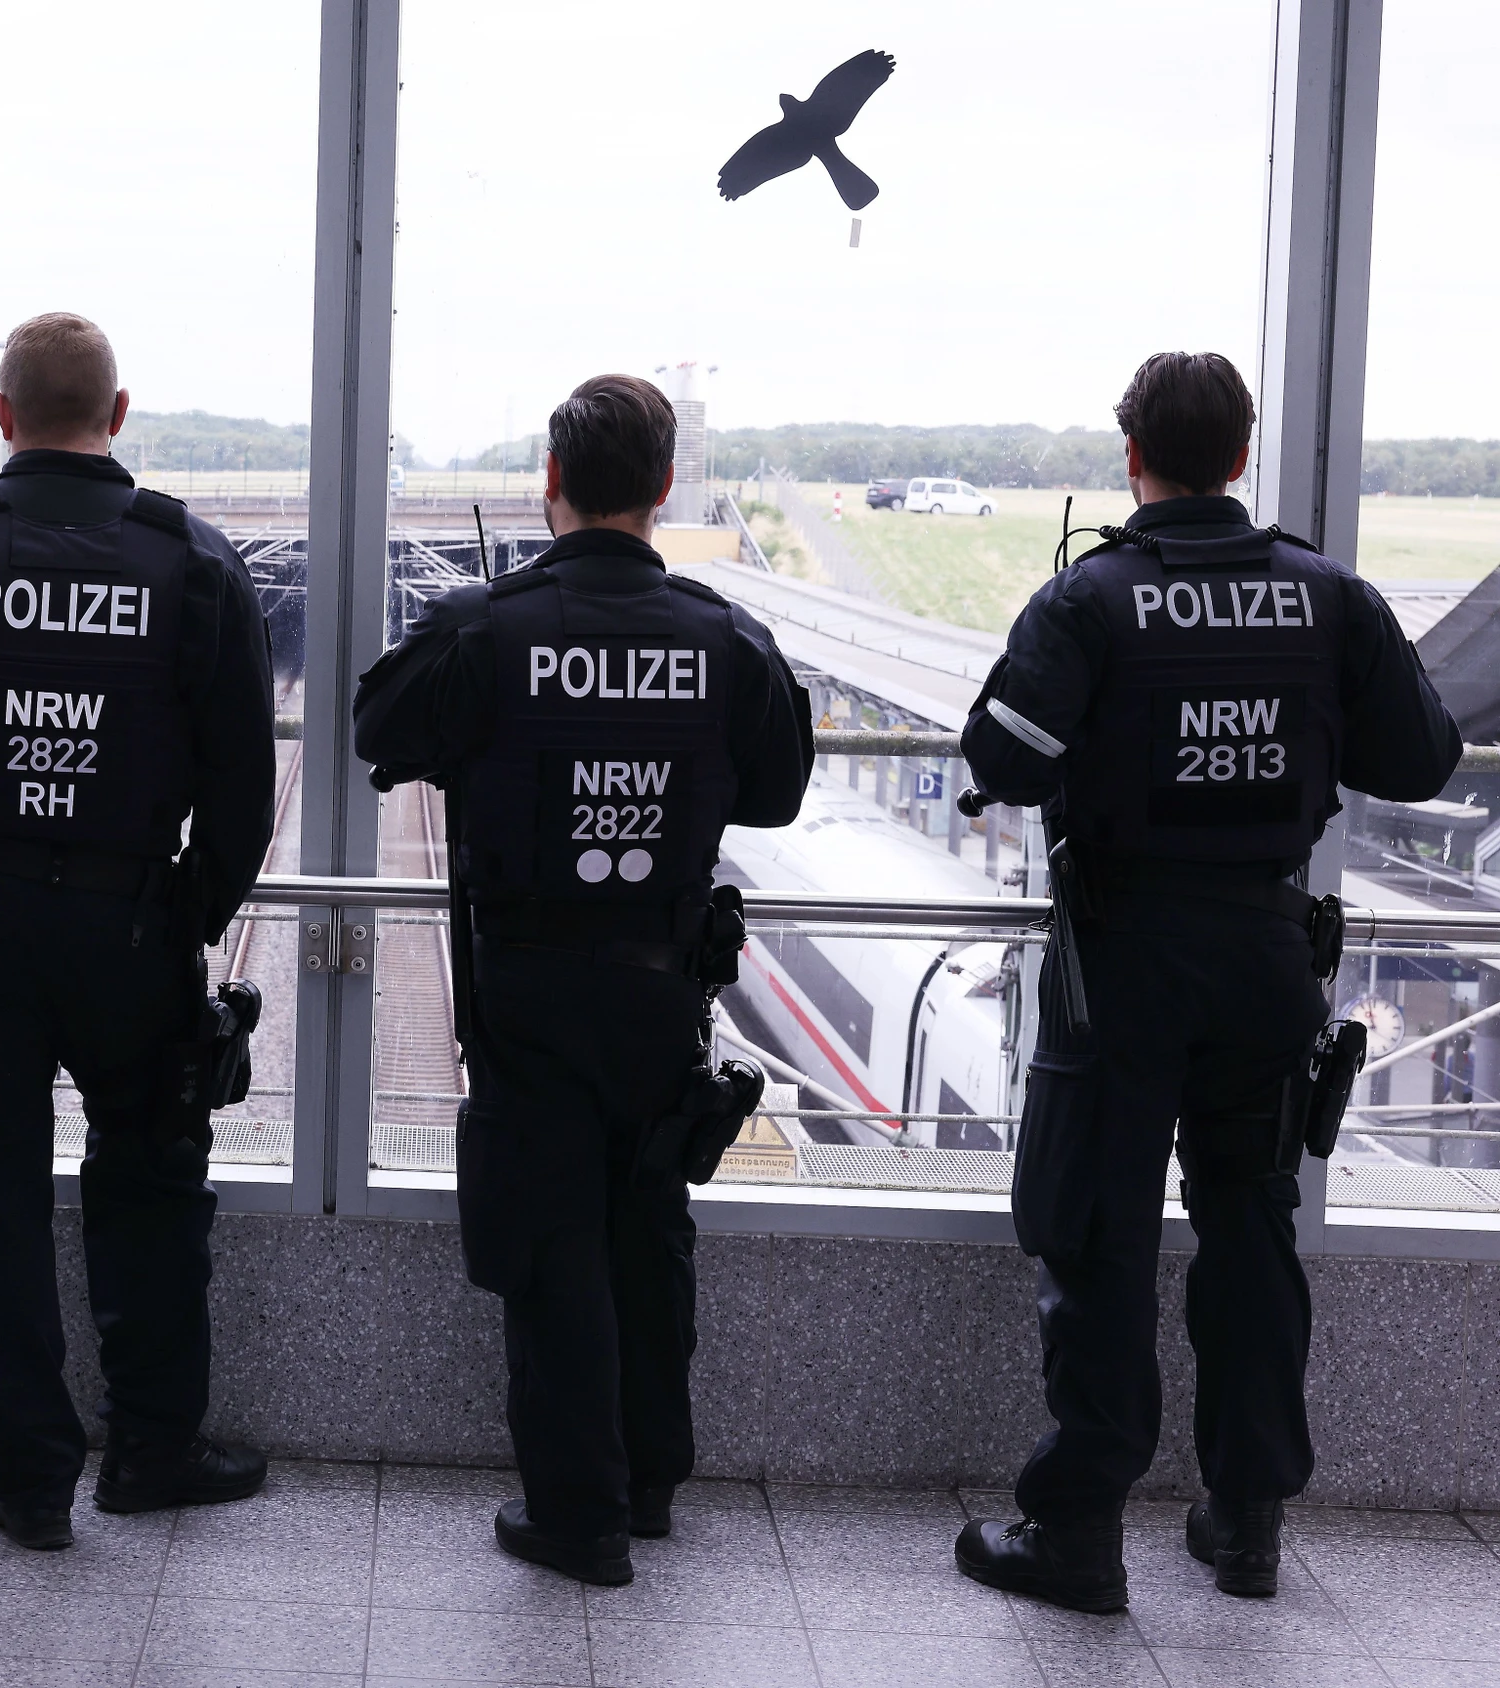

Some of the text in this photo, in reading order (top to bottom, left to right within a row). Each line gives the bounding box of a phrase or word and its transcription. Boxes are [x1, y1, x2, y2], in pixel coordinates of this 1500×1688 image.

[1133, 582, 1313, 628] POLIZEI
[531, 647, 706, 699] POLIZEI
[6, 690, 104, 729] NRW
[1181, 699, 1279, 737] NRW
[8, 736, 98, 773] 2822
[1177, 744, 1285, 781] 2813
[573, 761, 671, 795] NRW
[919, 774, 935, 794] D
[20, 782, 74, 817] RH
[572, 805, 662, 839] 2822
[720, 1157, 790, 1169] ochspannung
